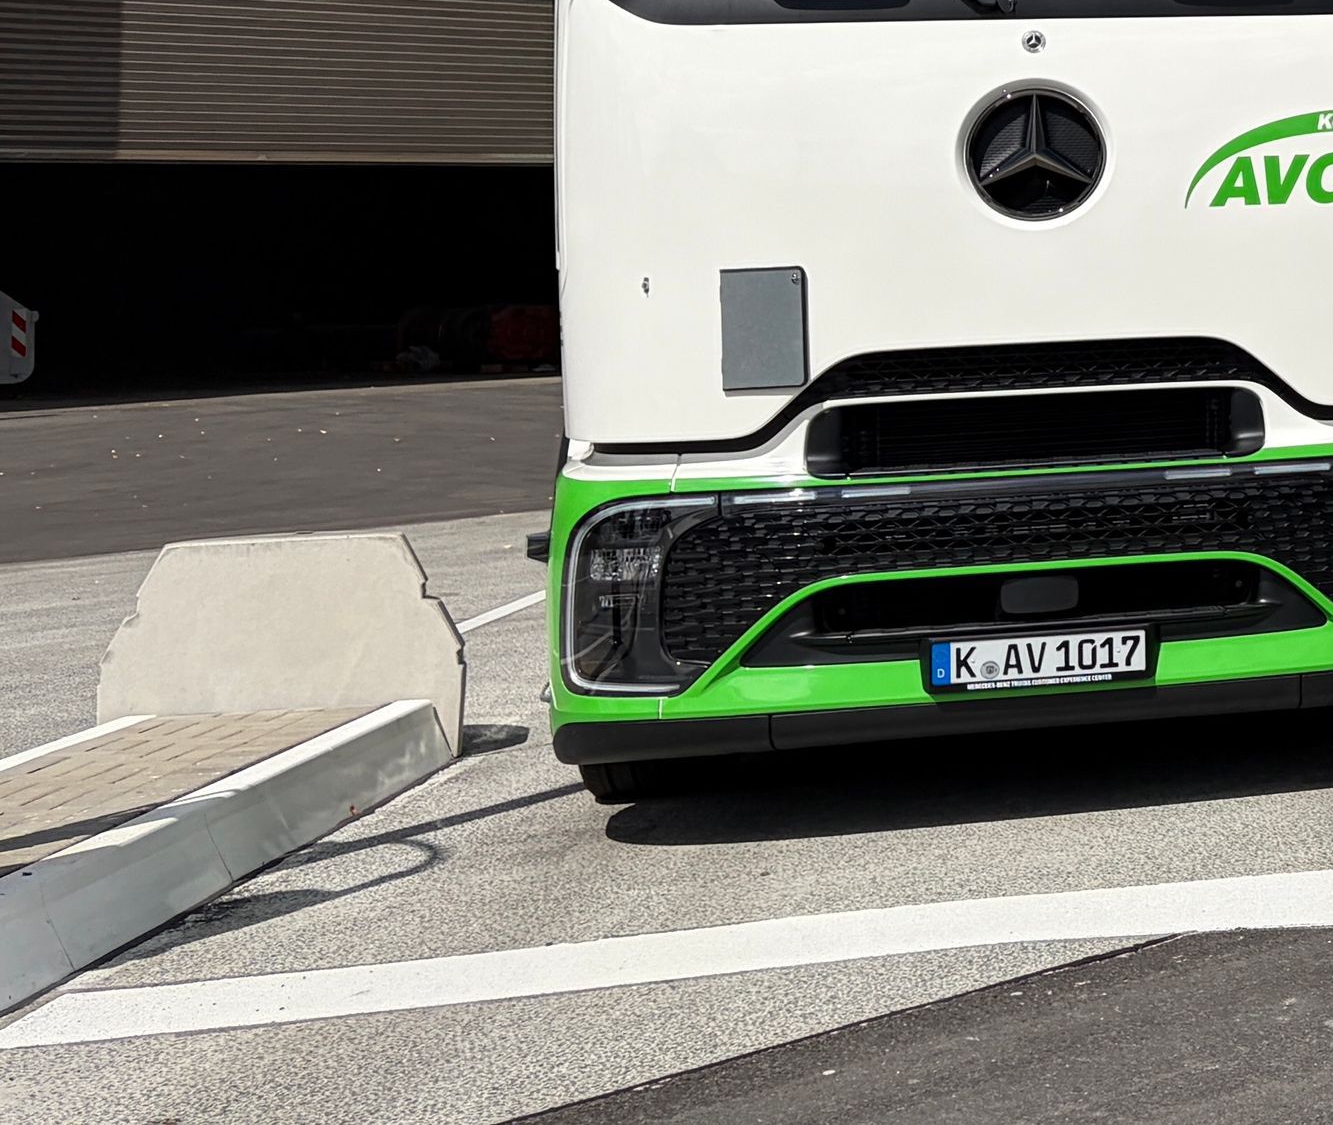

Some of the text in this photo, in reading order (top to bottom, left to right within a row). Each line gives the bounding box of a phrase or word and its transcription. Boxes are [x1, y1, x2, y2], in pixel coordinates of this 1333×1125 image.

[937, 635, 1141, 679] D K AV 1017
